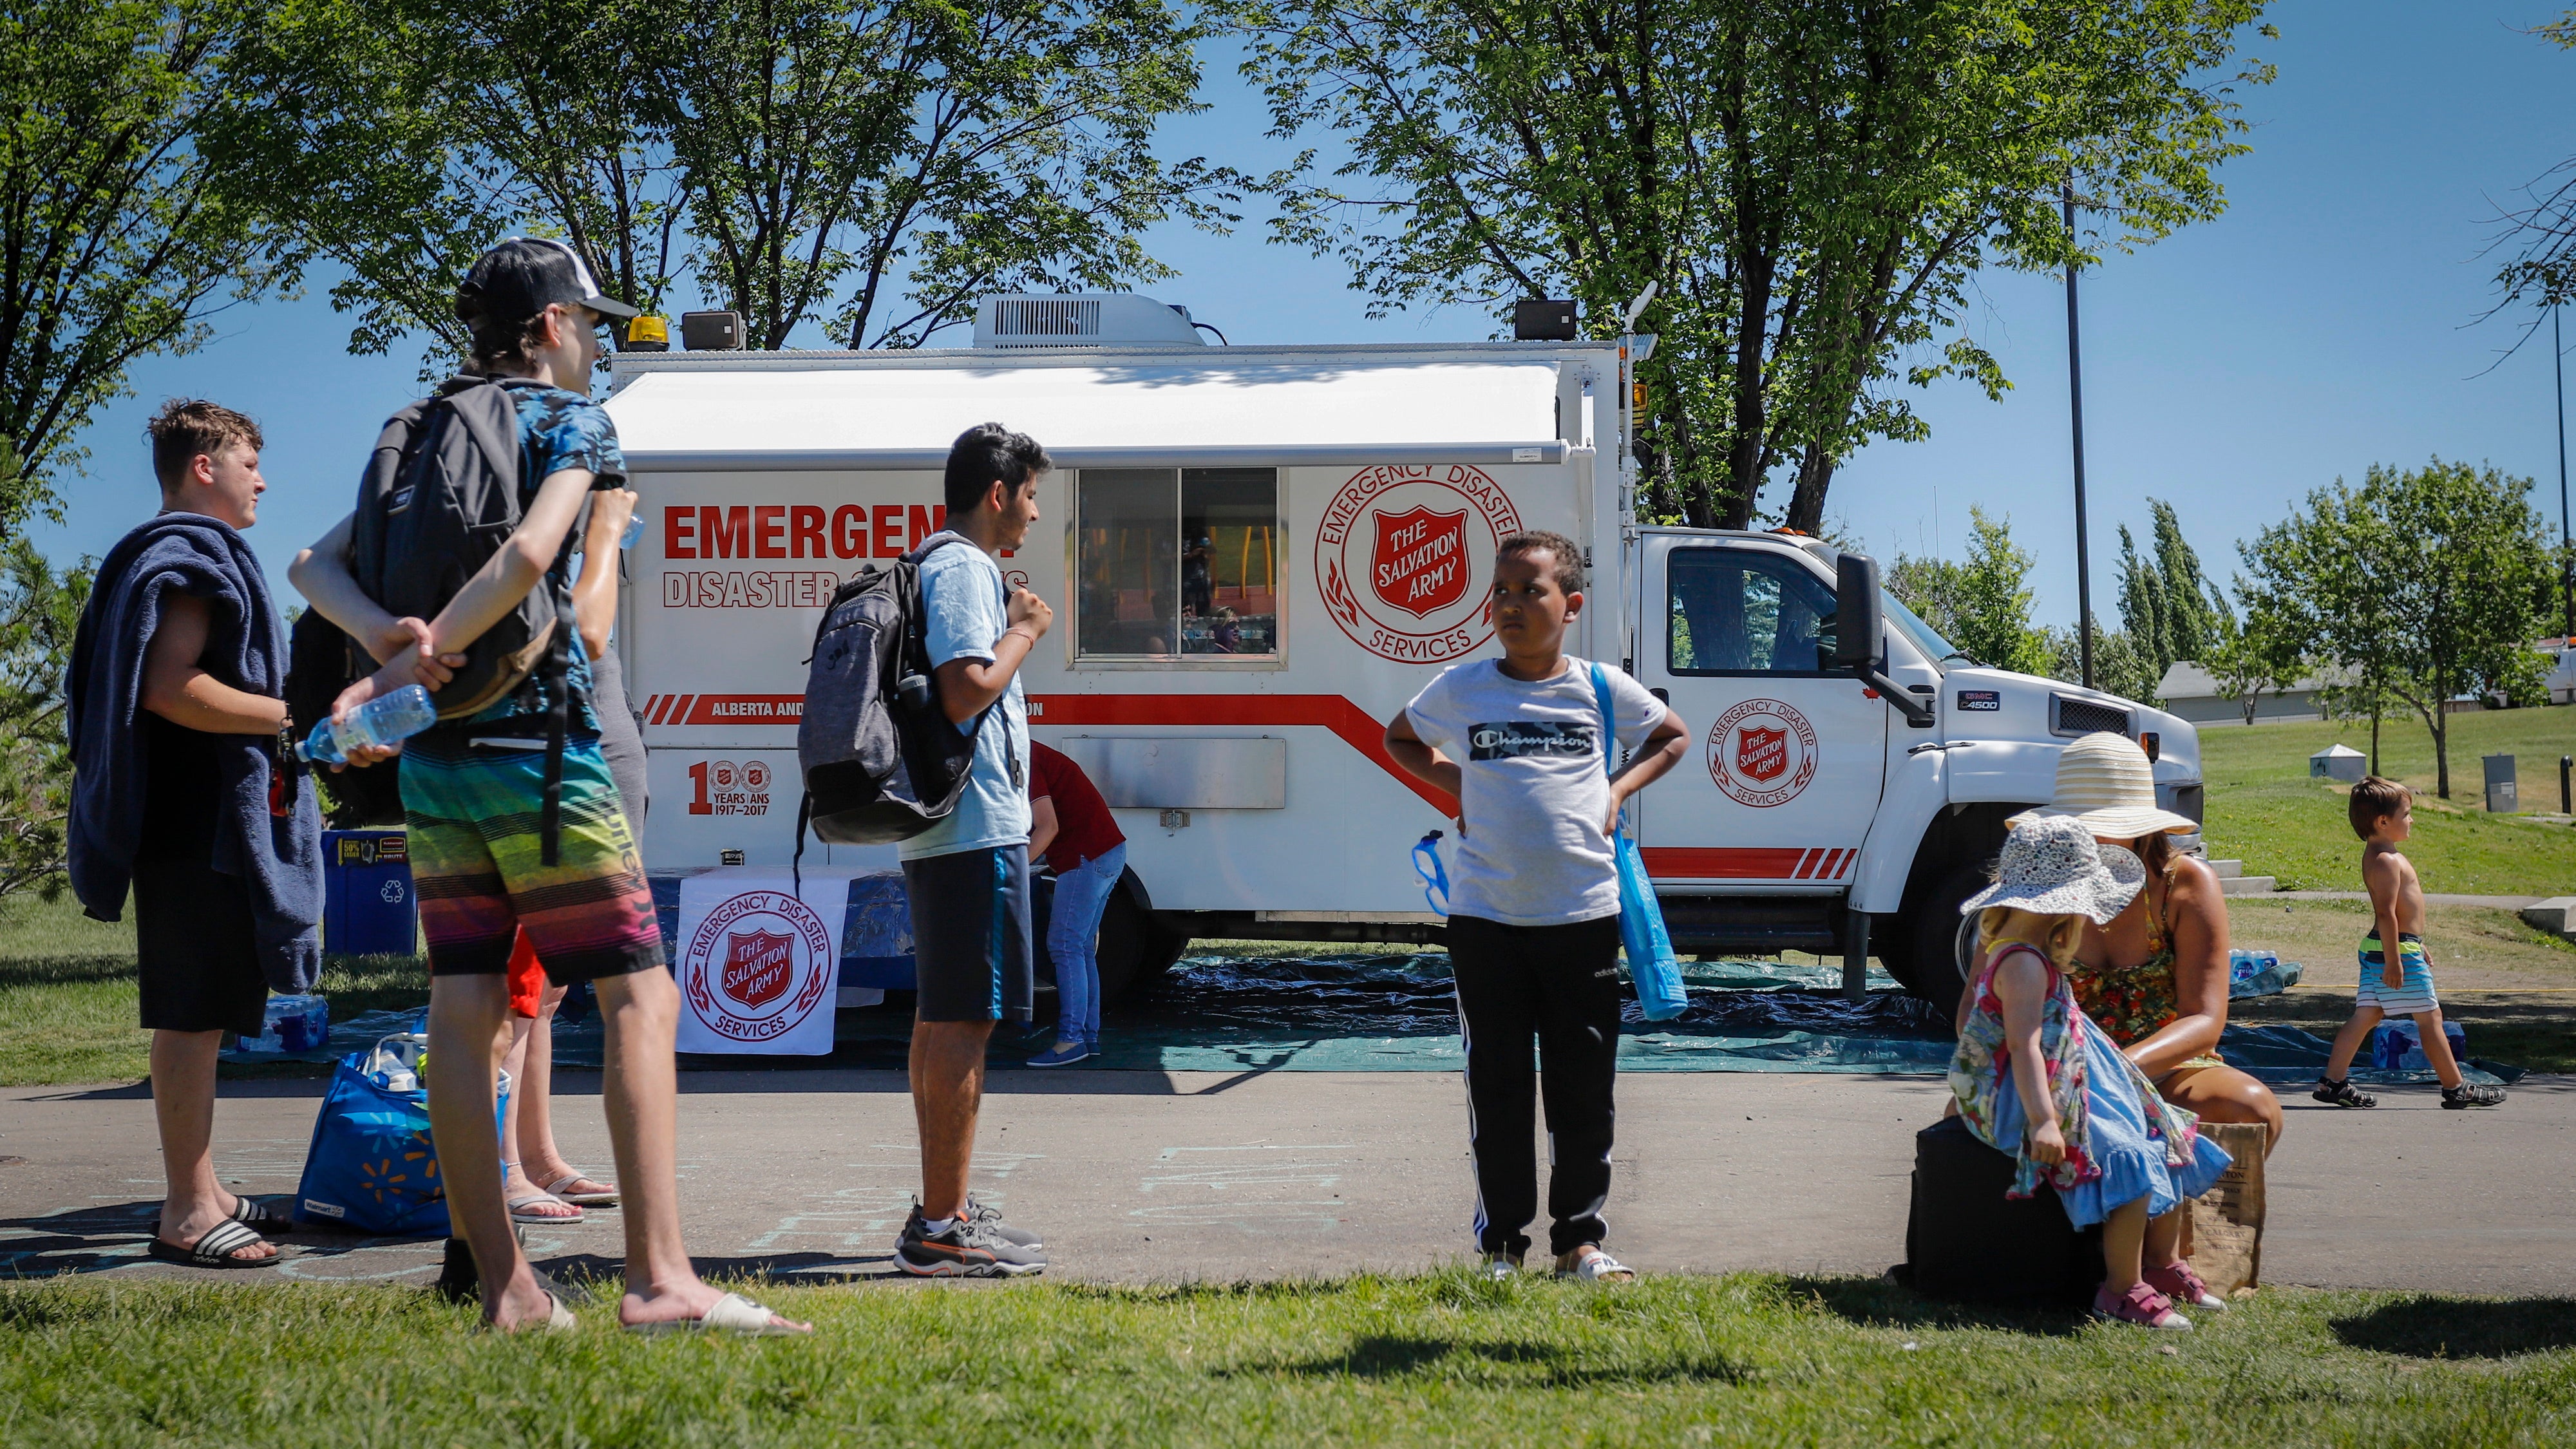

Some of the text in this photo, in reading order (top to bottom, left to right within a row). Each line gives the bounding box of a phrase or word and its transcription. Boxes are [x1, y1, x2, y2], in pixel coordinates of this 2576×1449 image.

[665, 505, 1014, 559] EMERGEN
[1390, 519, 1427, 552] THE
[1378, 526, 1457, 587] SALVATION
[1408, 556, 1457, 602] ARMY
[1369, 629, 1471, 658] SERVICES
[712, 702, 773, 716] ALBERTA
[1711, 701, 1814, 746] EMERGENCY DISASTER
[1473, 730, 1591, 752] Champion
[1740, 737, 1783, 767] SALVATION
[1747, 733, 1766, 750] THE
[1756, 752, 1782, 775] ARMY
[714, 793, 770, 804] YEARS ANS
[1735, 789, 1788, 804] SERVICES
[344, 844, 359, 852] 50%
[692, 896, 825, 957] EMERGENCY DISASTER
[738, 937, 764, 962] THE
[726, 942, 787, 989] SALVATION
[745, 963, 783, 999] ARMY
[715, 1016, 786, 1037] SERVICES
[306, 1201, 331, 1213] Walmart
